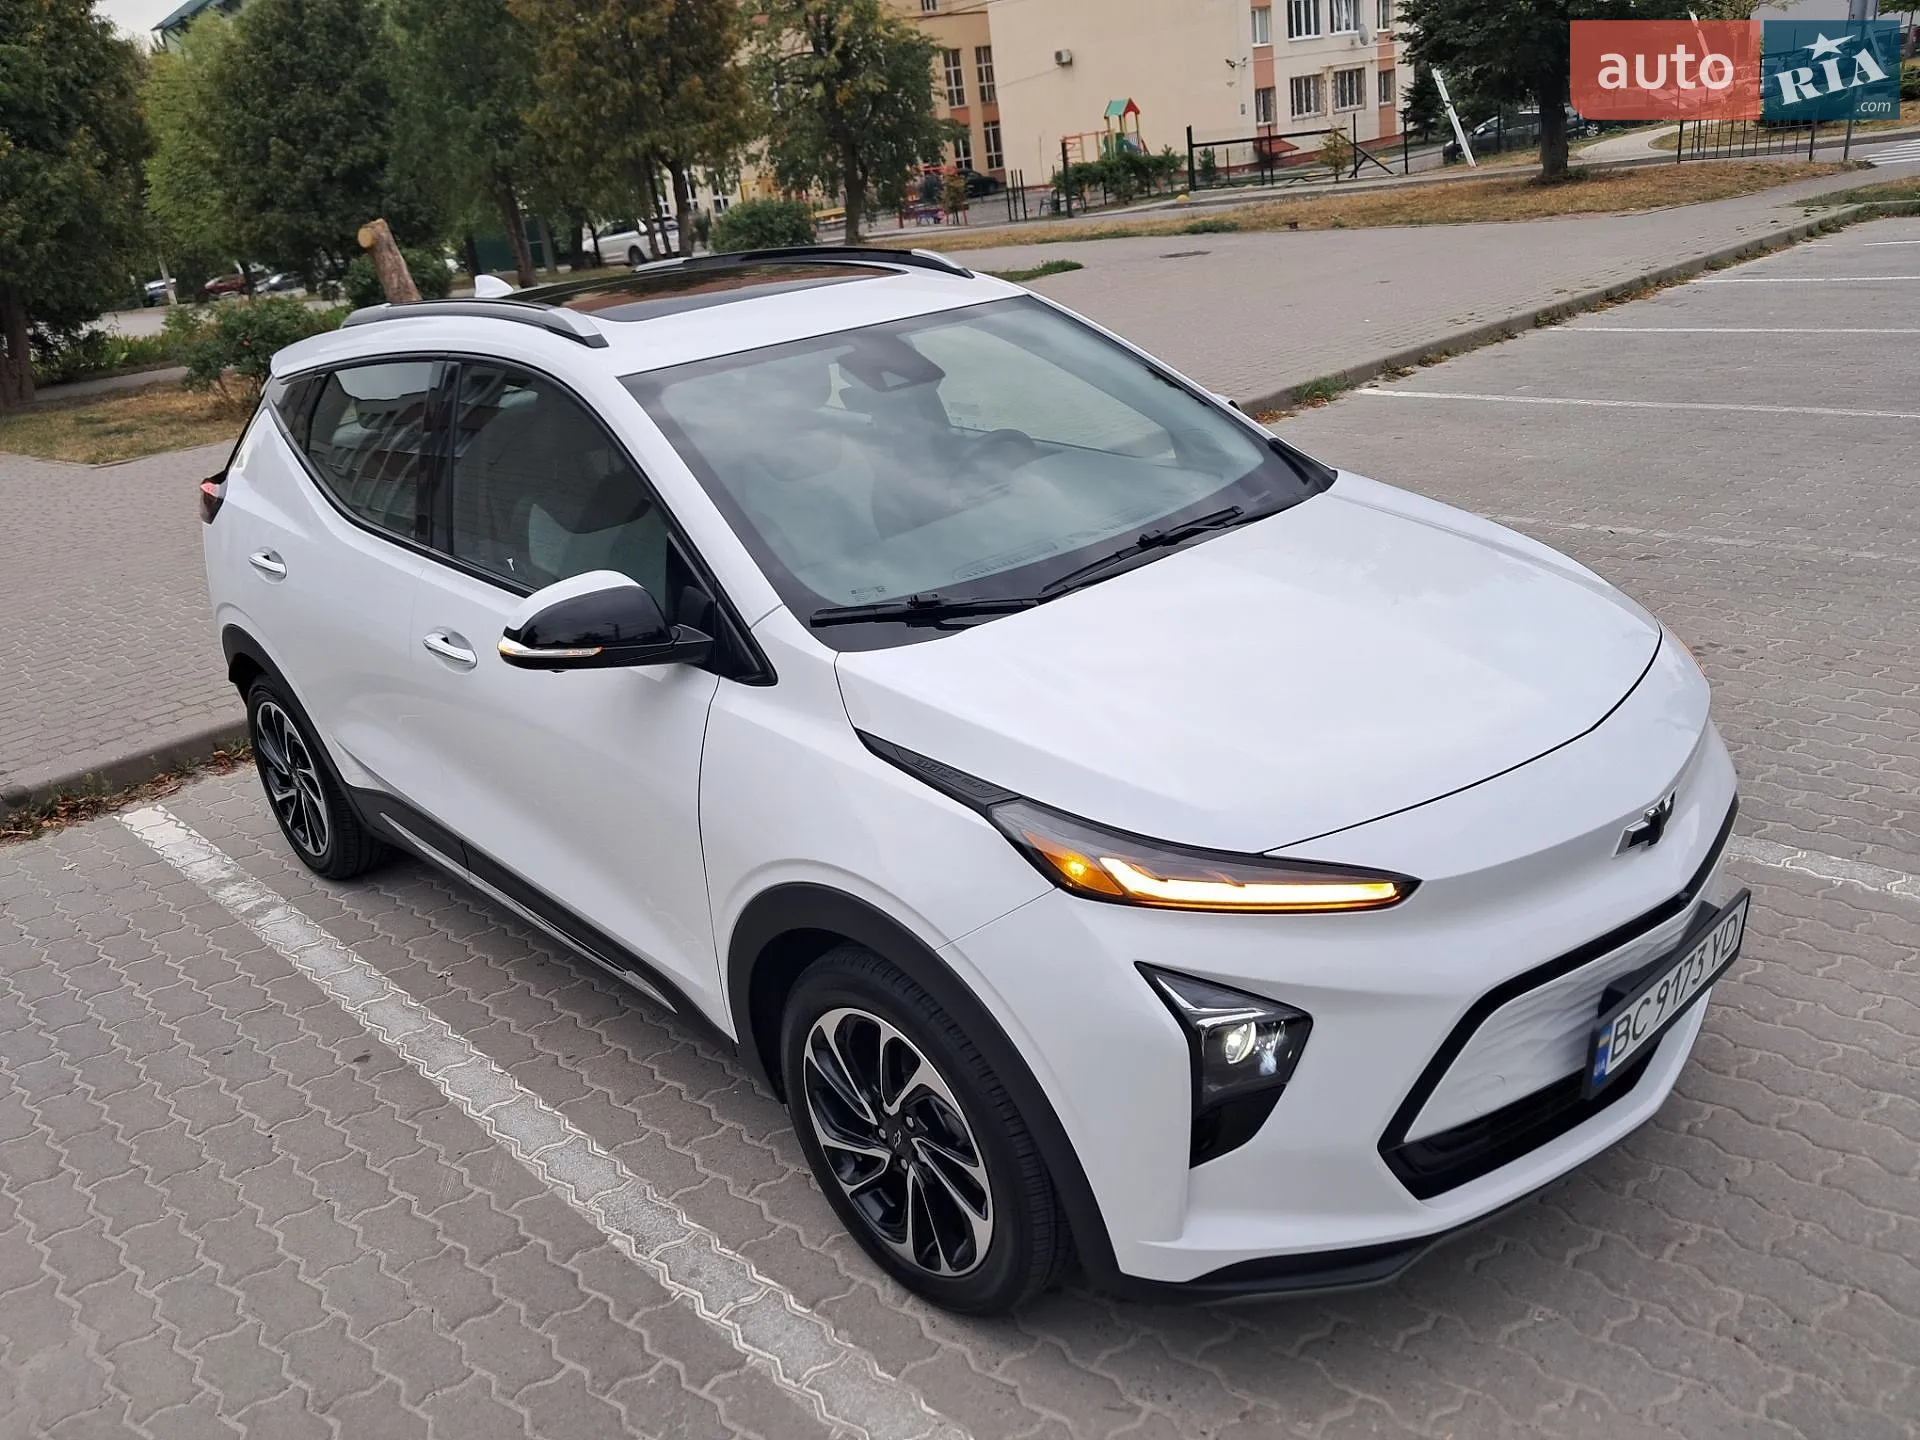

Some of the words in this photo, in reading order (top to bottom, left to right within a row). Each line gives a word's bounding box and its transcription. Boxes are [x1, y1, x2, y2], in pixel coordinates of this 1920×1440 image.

[1610, 997, 1650, 1063] BC
[1654, 942, 1707, 1025] 9173
[1711, 914, 1738, 968] YD
